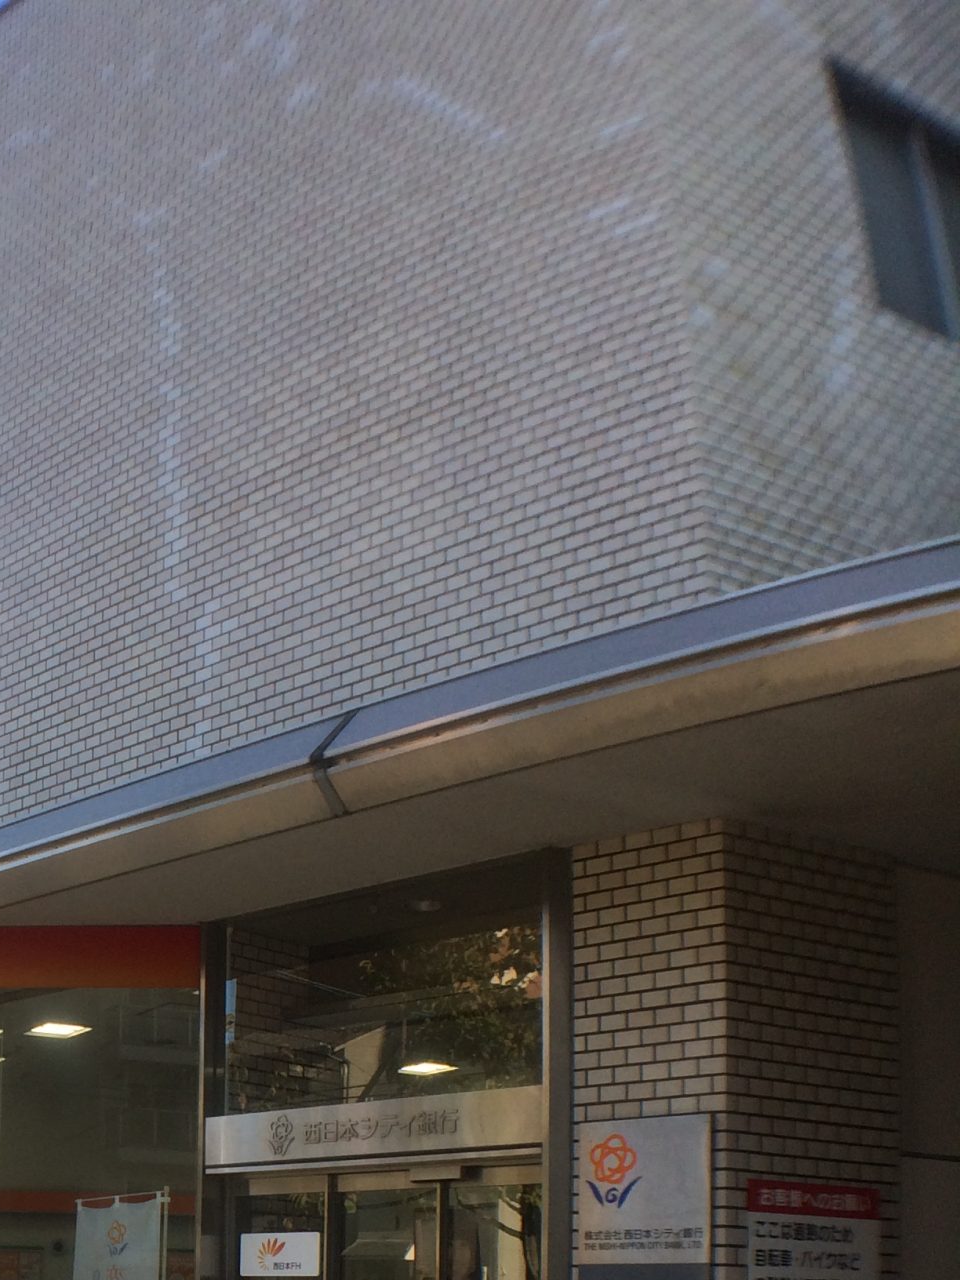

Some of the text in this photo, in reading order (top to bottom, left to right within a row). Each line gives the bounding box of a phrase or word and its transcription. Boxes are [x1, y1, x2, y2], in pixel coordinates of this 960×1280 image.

[304, 1109, 460, 1145] 西日本シティ銀行
